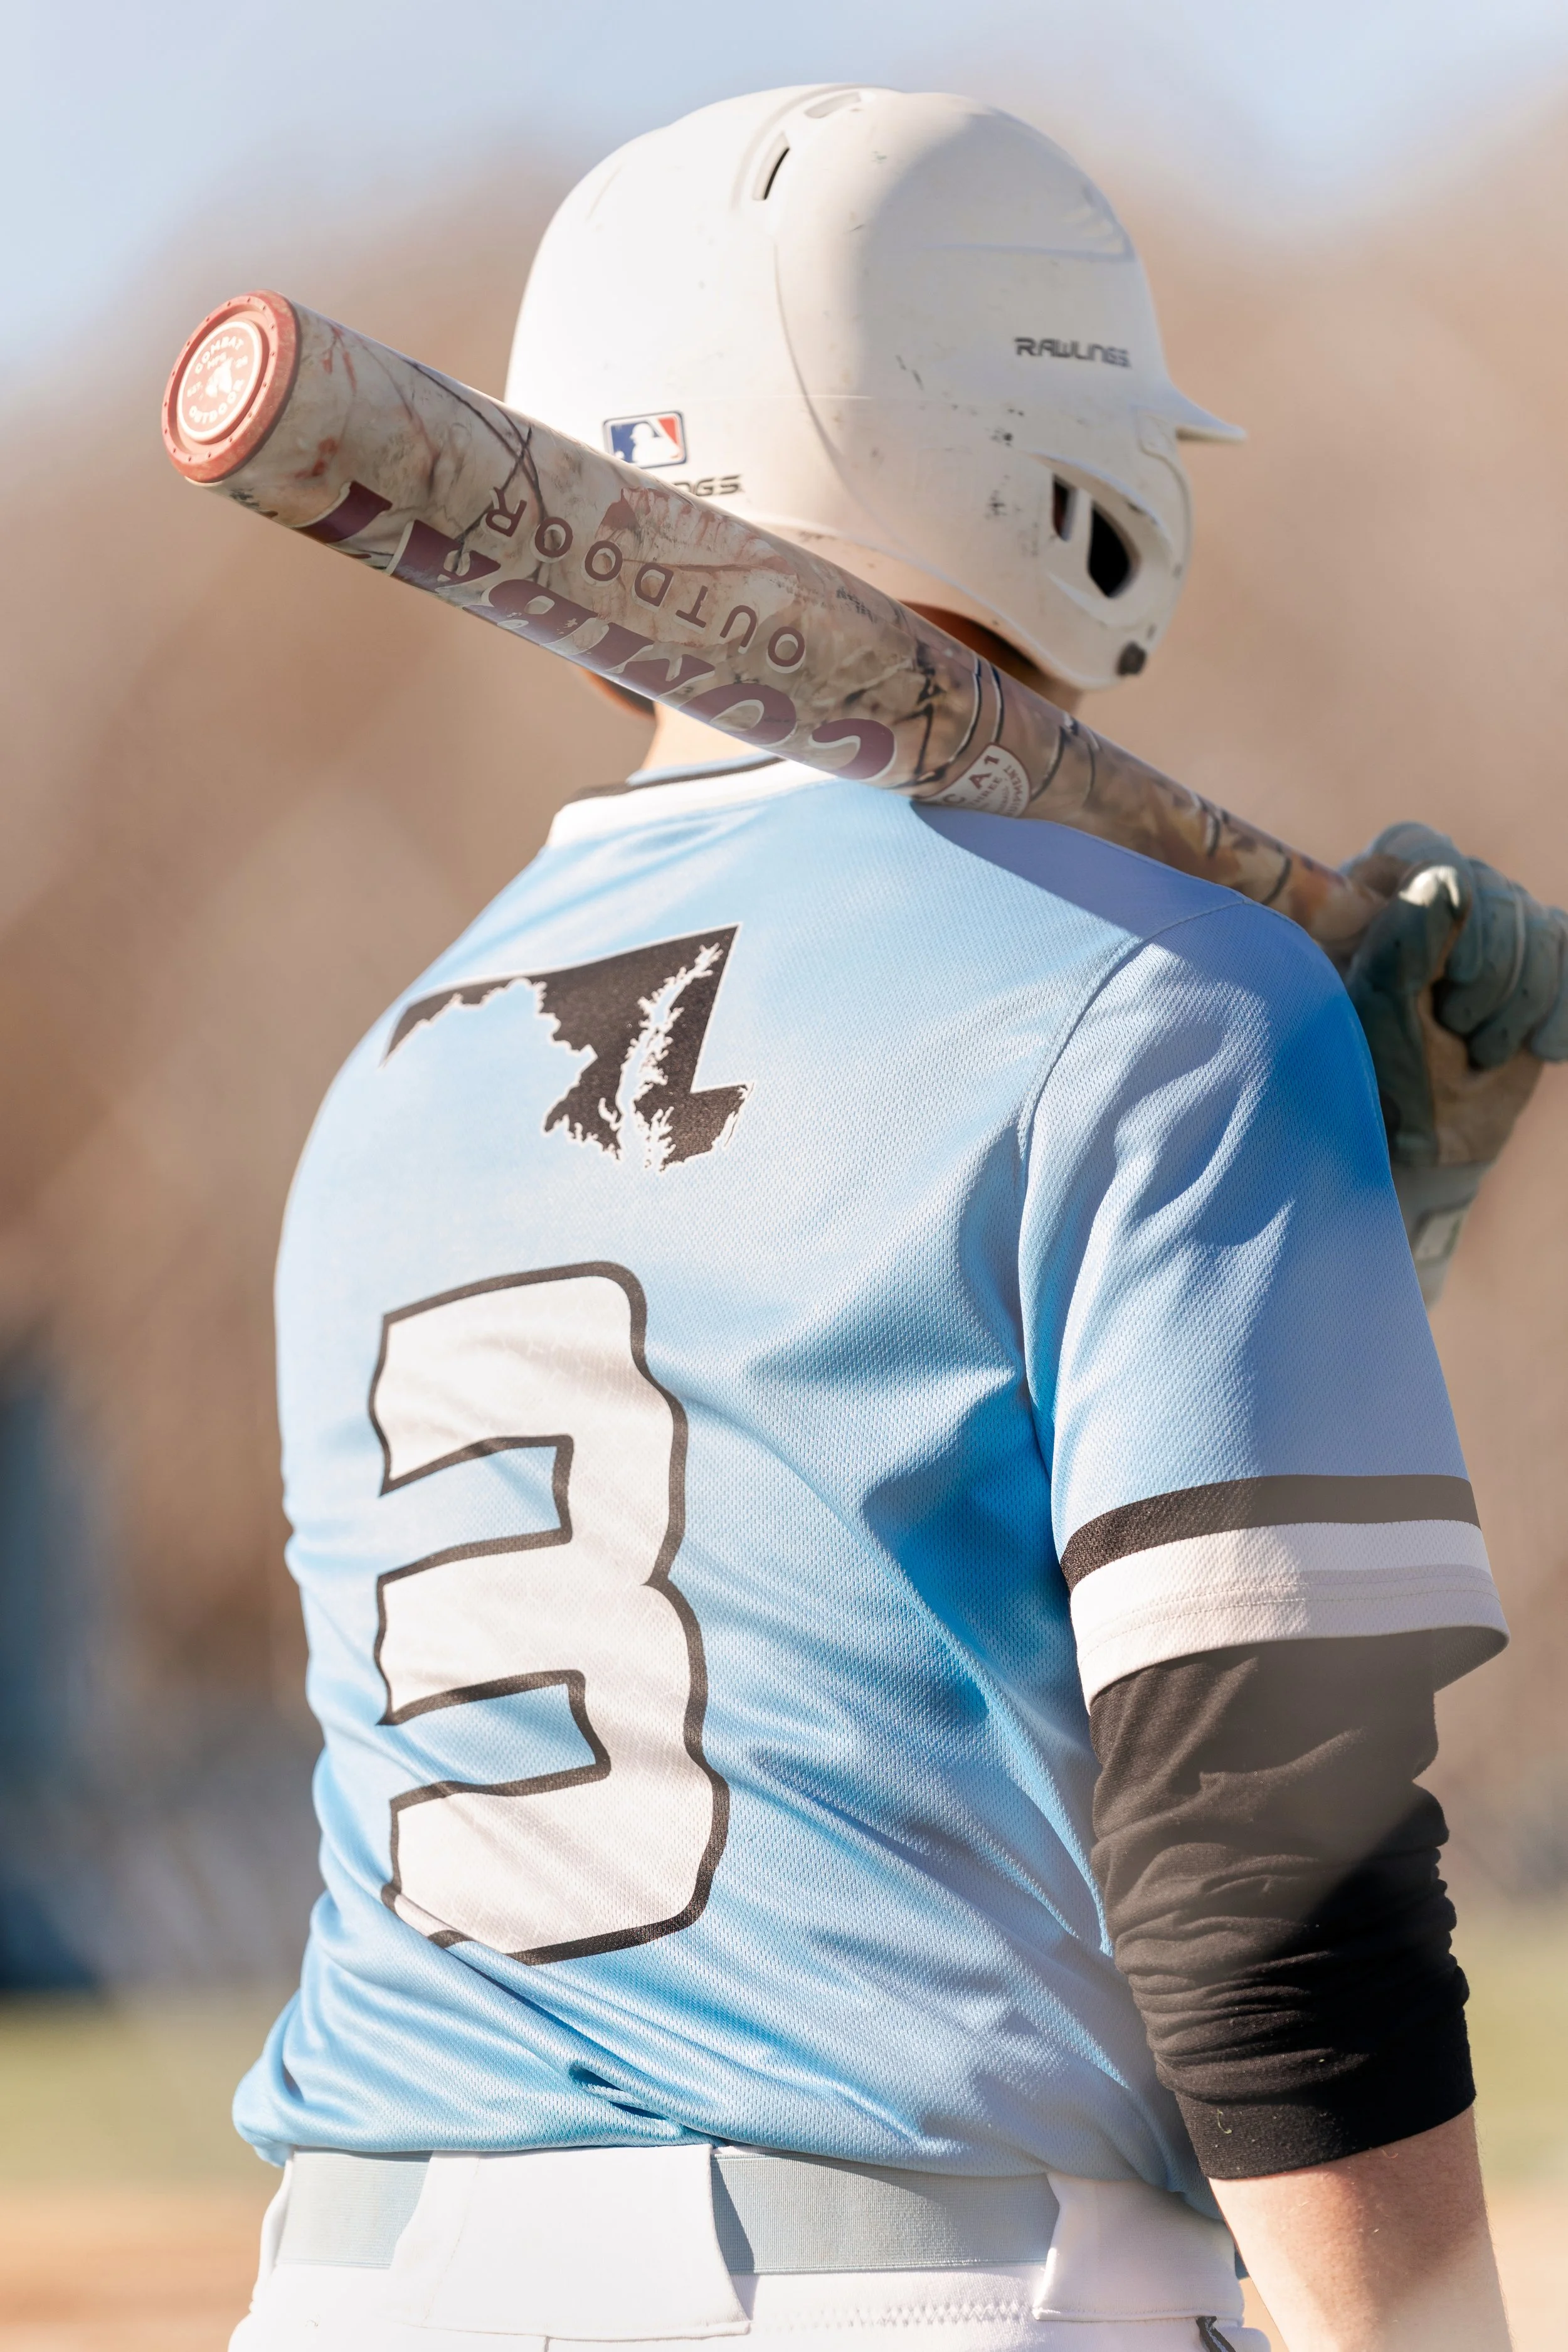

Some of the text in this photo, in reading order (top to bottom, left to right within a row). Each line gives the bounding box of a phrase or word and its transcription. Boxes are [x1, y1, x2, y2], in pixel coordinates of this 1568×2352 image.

[1014, 337, 1131, 369] RAWLINGS
[480, 487, 806, 672] OUTDOOR
[369, 1259, 729, 1966] 3
